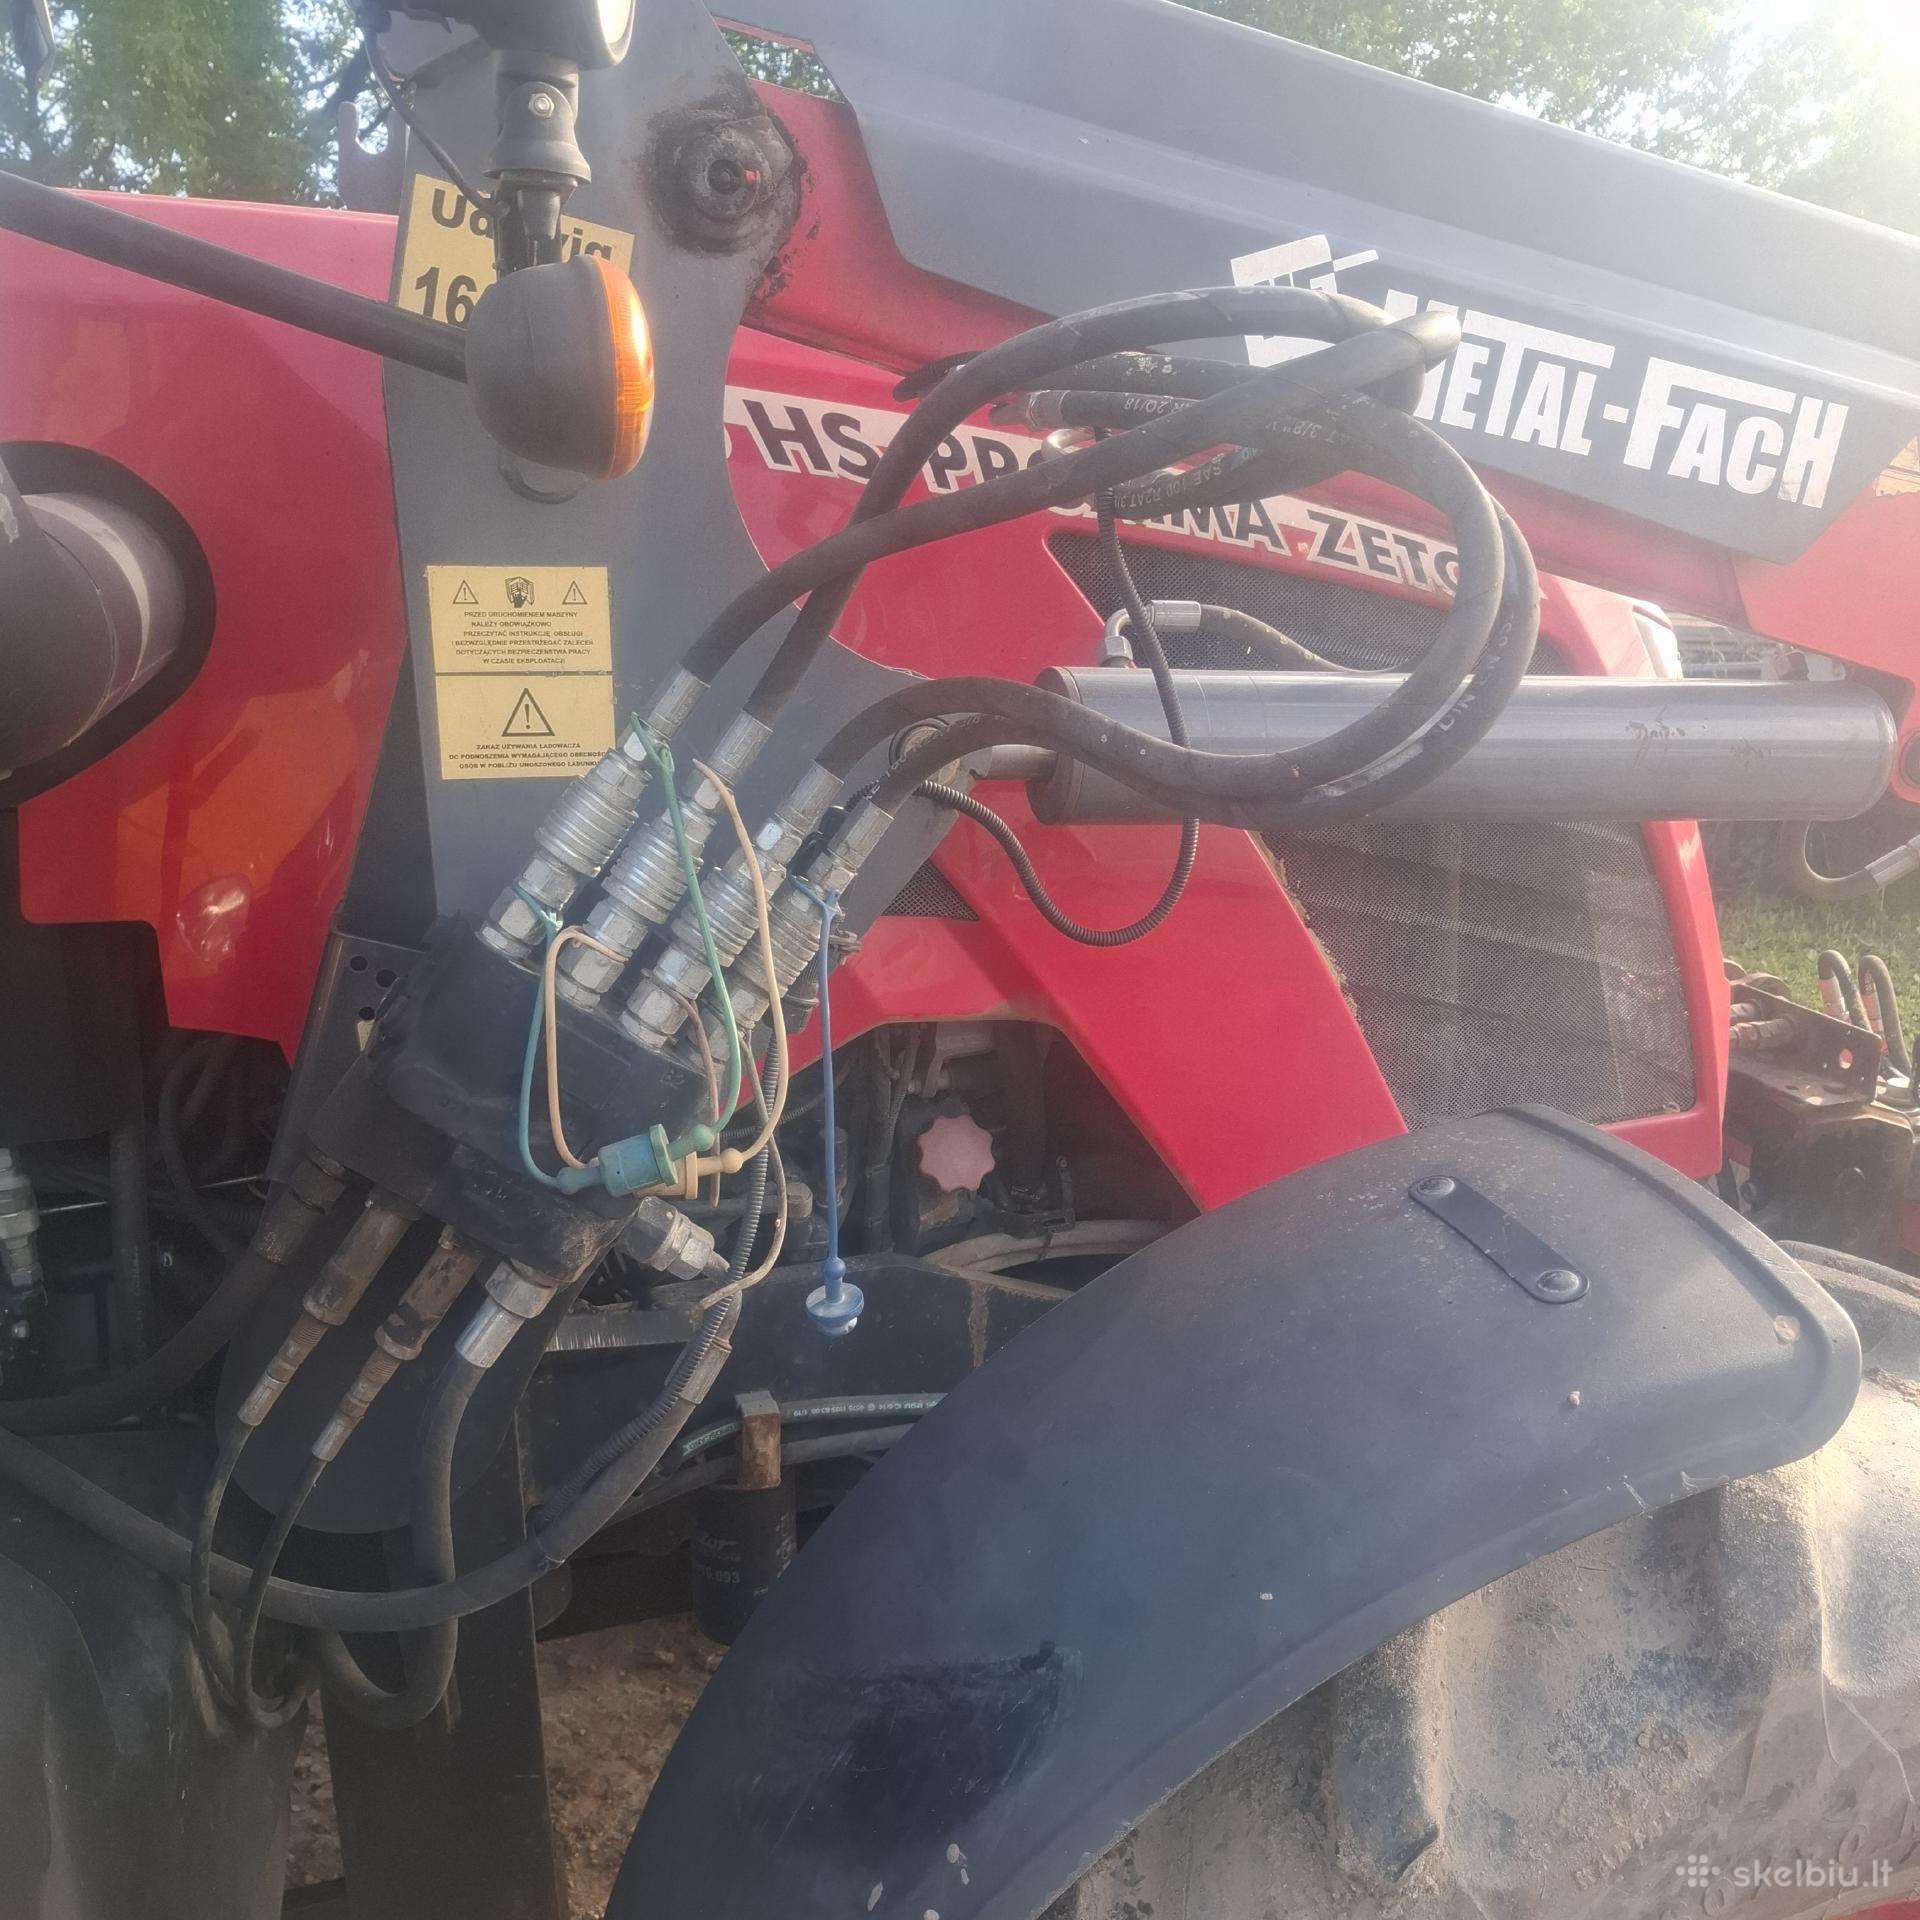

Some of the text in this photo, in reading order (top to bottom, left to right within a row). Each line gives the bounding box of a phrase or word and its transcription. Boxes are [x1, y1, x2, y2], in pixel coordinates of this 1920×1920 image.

[741, 397, 882, 485] HS
[1305, 506, 1460, 598] ZETO
[464, 610, 578, 618] PRZED URUCHOMIENIEM MASZYNY
[568, 648, 591, 656] PRACY
